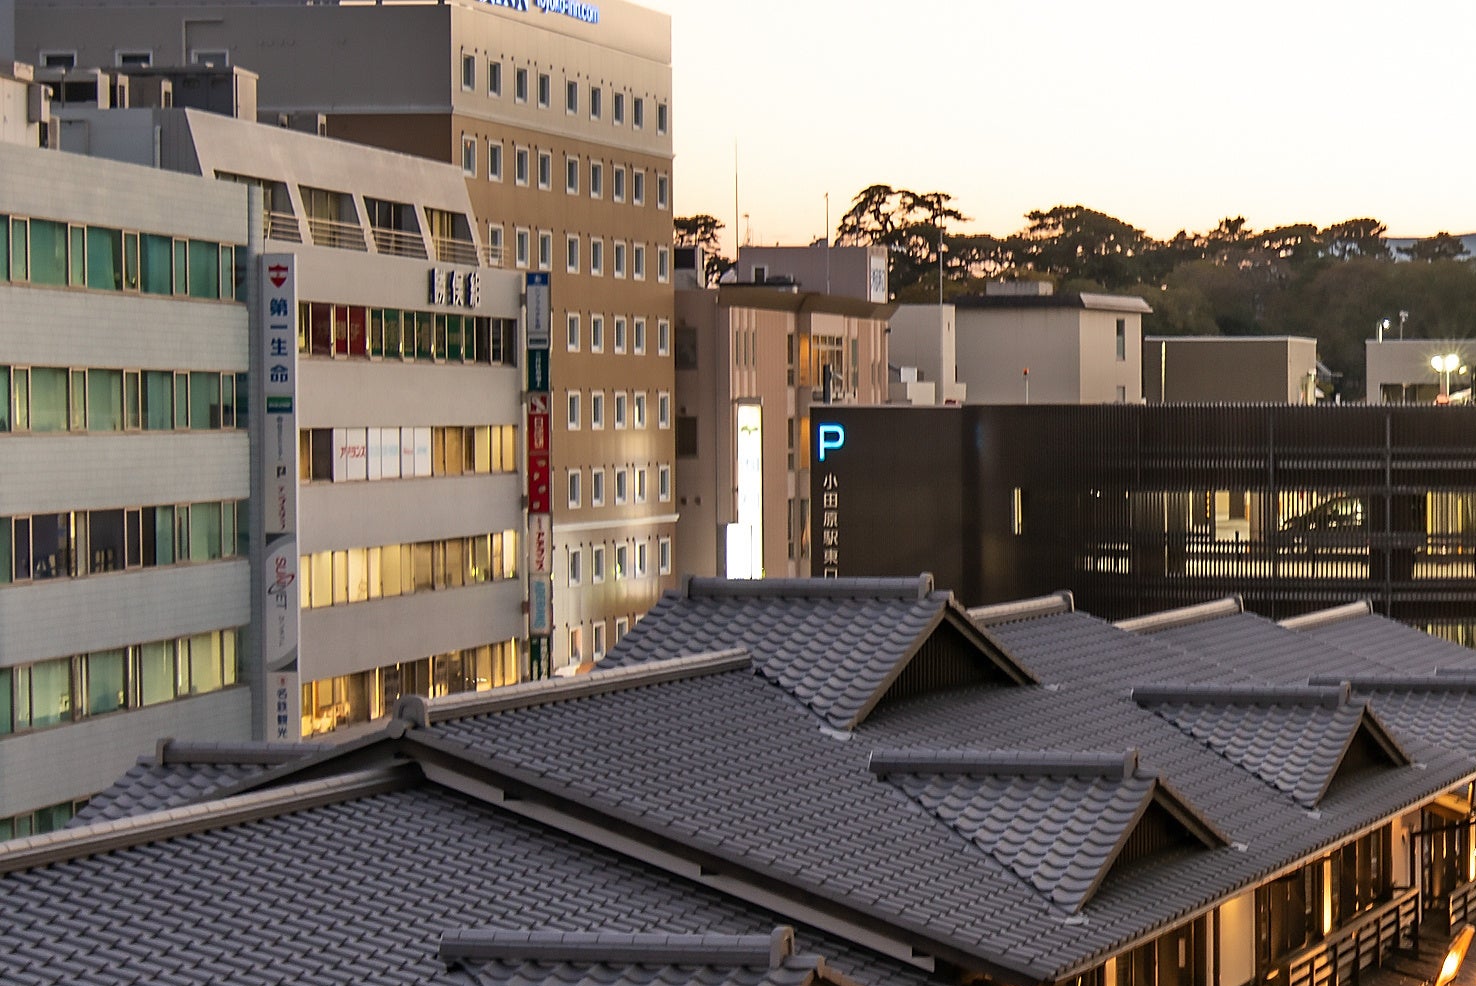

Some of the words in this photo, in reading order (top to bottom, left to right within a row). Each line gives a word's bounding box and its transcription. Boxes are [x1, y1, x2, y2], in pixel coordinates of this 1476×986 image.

[269, 297, 289, 384] 第一生命
[818, 422, 845, 463] P
